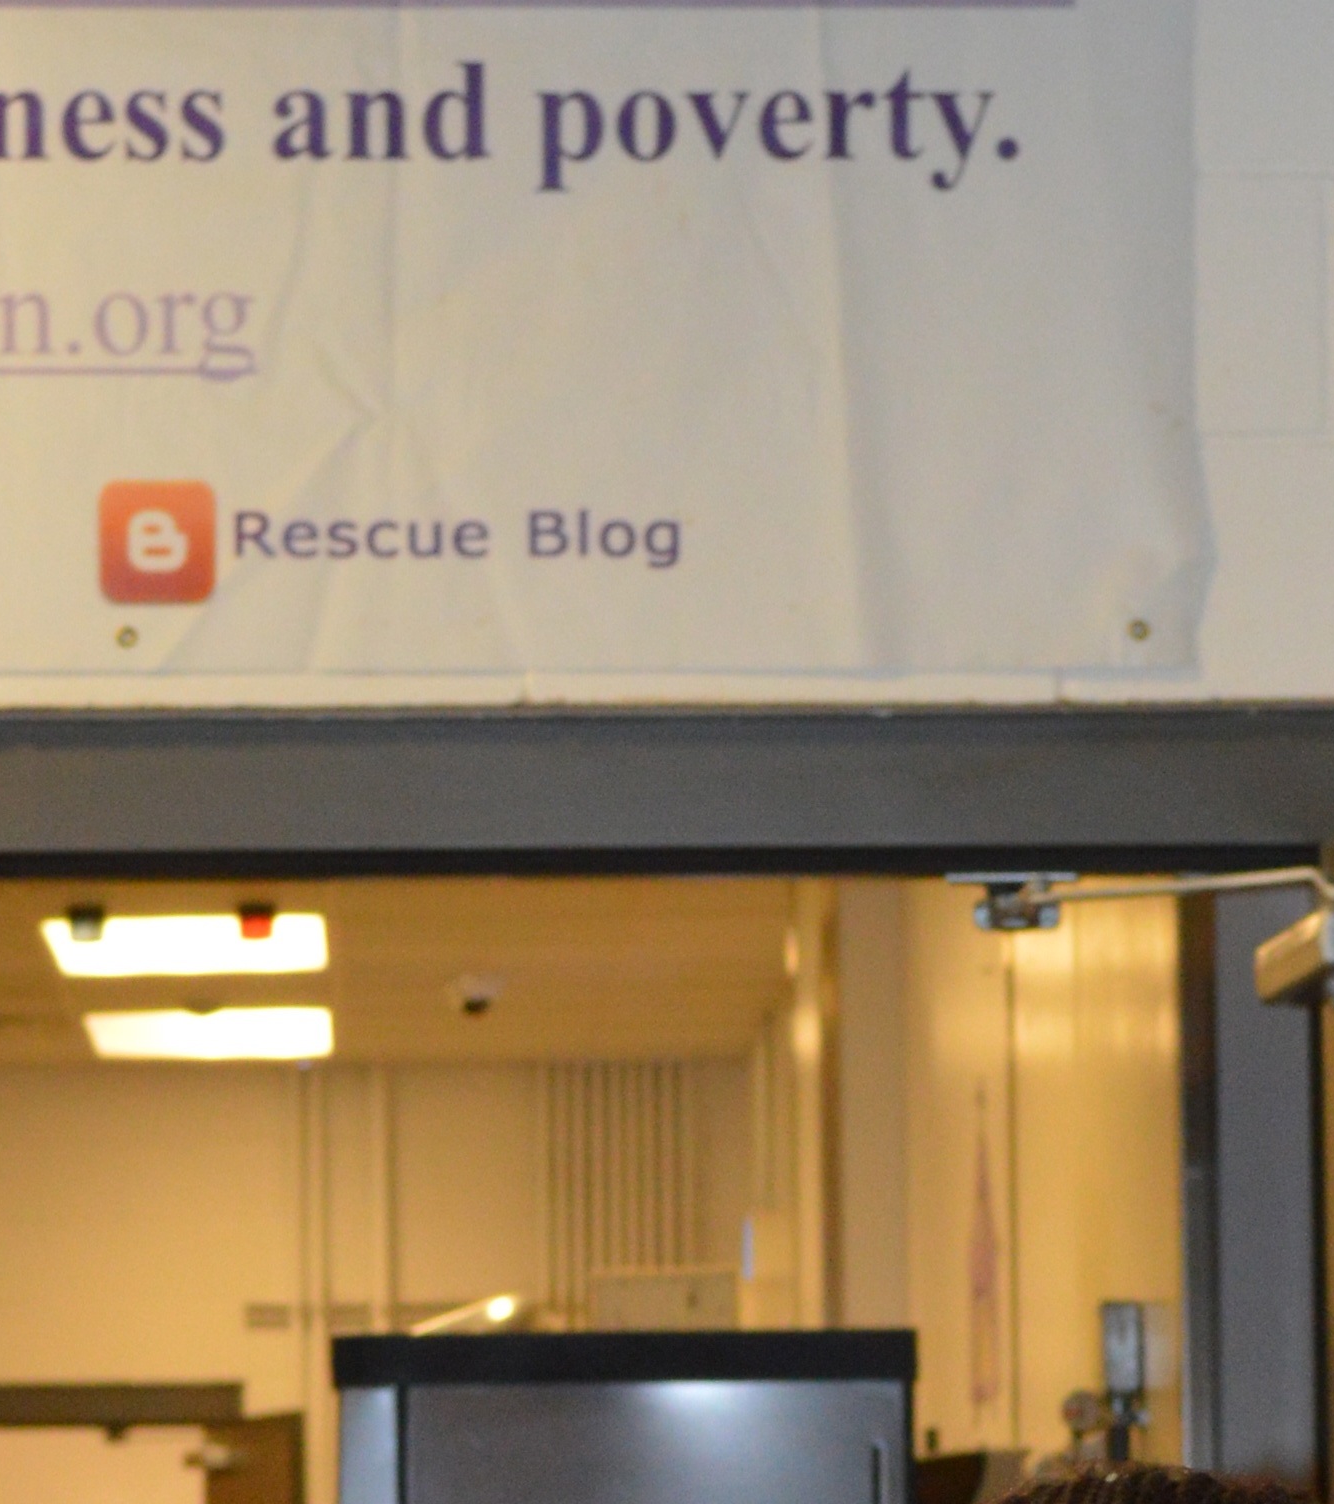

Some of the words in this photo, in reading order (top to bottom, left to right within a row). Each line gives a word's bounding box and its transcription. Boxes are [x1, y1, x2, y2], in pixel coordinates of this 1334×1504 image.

[271, 61, 492, 165] and
[534, 67, 1023, 193] poverty.
[231, 509, 494, 561] Rescue
[526, 508, 685, 568] Blog
